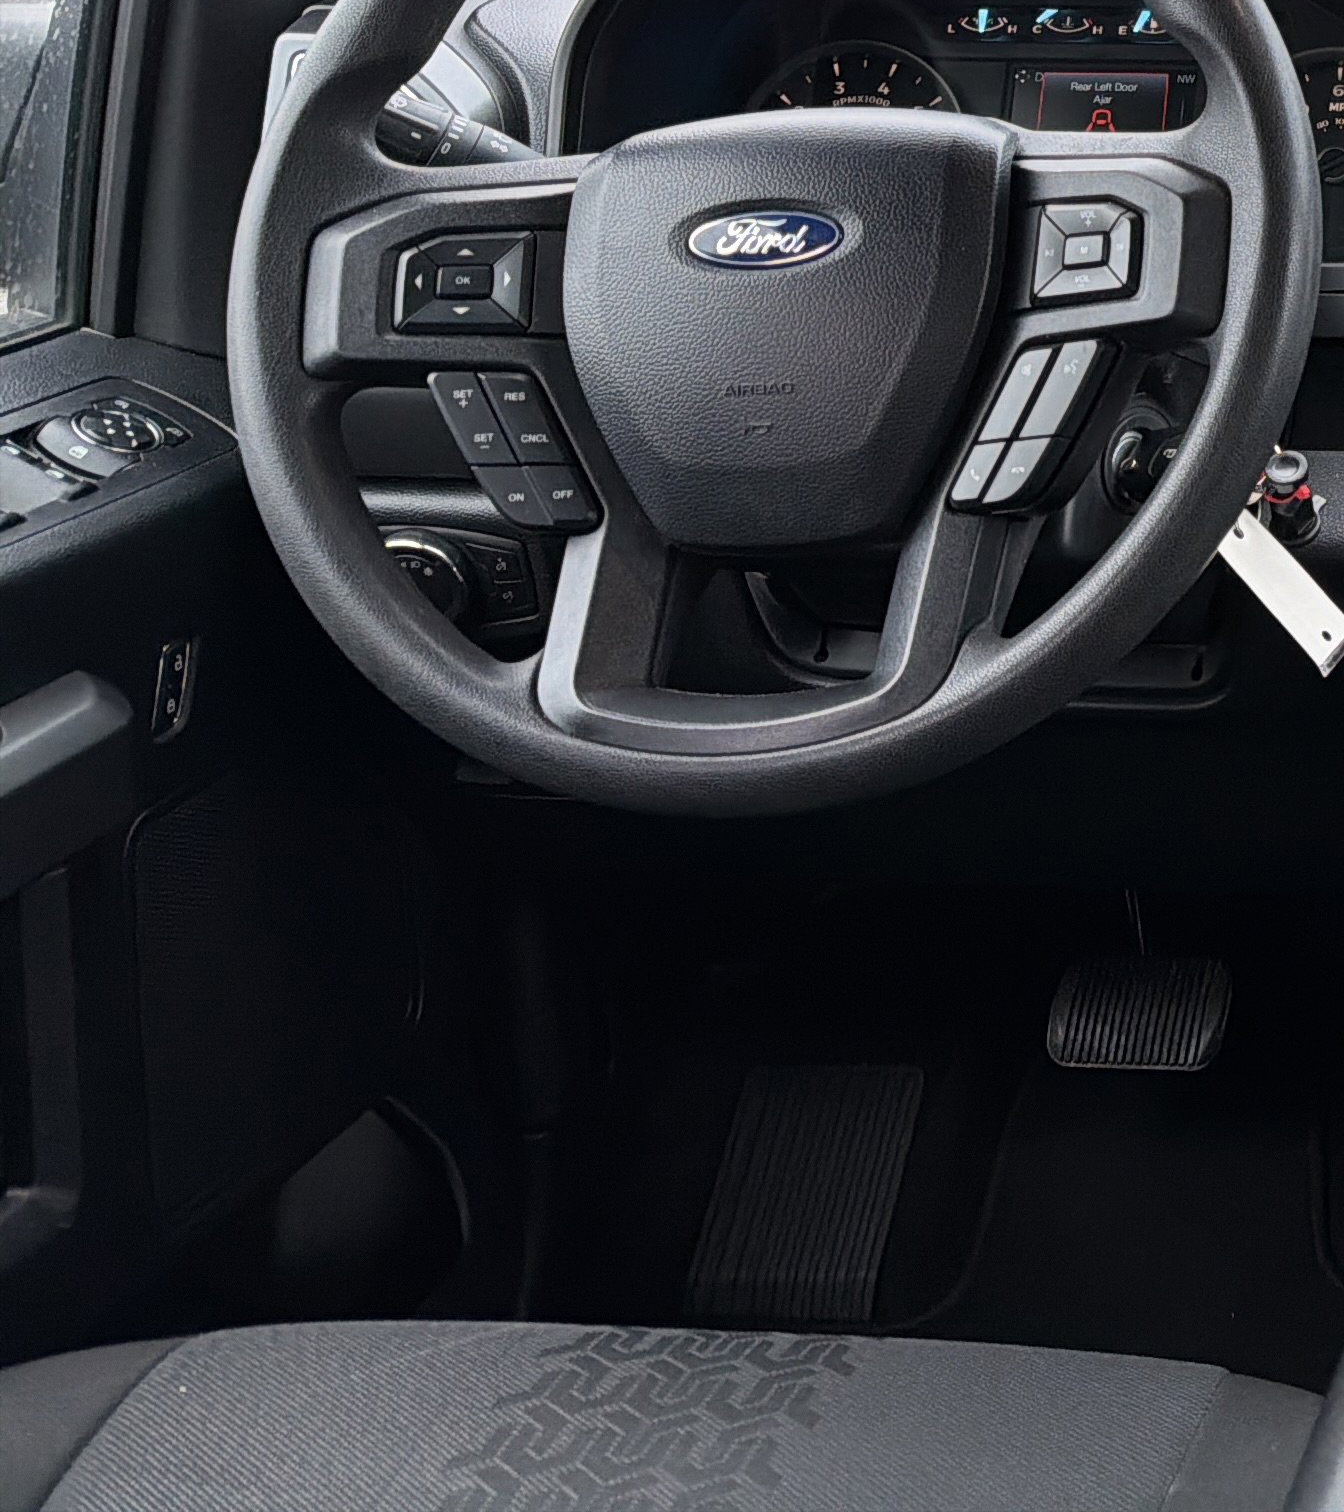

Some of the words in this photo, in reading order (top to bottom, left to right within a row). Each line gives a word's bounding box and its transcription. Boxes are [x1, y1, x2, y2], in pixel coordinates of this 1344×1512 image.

[948, 24, 956, 34] L
[1008, 24, 1018, 34] H
[1032, 24, 1042, 34] C
[1092, 26, 1103, 35] H
[1118, 26, 1128, 35] E
[1177, 74, 1196, 84] NW
[833, 82, 846, 94] 3
[877, 82, 891, 95] 4
[1071, 82, 1092, 92] Rear
[1094, 82, 1112, 92] Left
[1114, 82, 1138, 92] Door
[1093, 95, 1112, 106] Ajar
[1080, 210, 1096, 219] VOL
[716, 218, 808, 256] Ford
[455, 276, 470, 285] OK
[452, 389, 474, 399] SET
[504, 392, 526, 402] RES
[474, 432, 494, 443] SET
[520, 434, 550, 443] CNCL
[508, 492, 524, 502] ON
[552, 490, 574, 500] OFF
